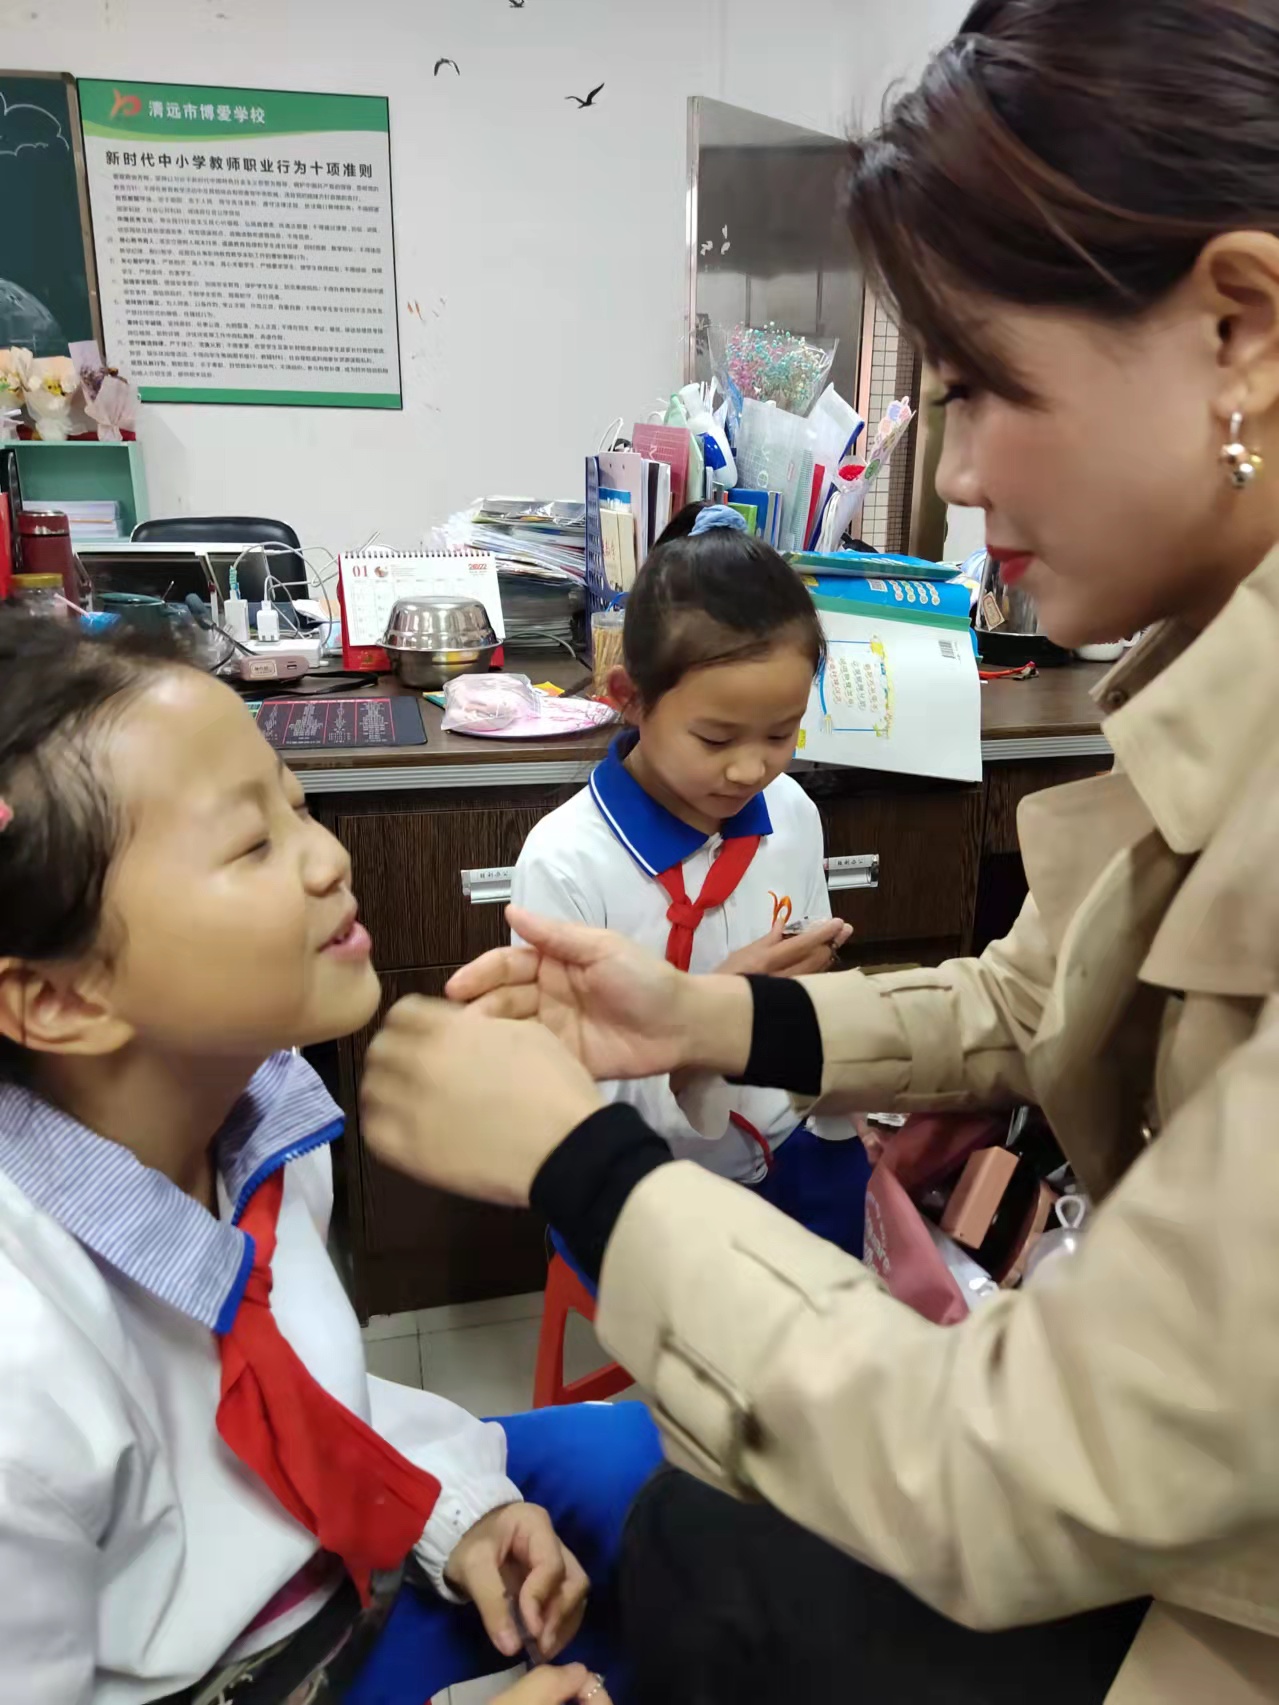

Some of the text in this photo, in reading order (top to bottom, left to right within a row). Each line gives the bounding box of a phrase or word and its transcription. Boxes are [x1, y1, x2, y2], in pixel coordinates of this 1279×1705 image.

[148, 100, 266, 124] 清远市博爱学校
[105, 150, 374, 179] 新时代中小学教师职业行为十项准则
[352, 565, 369, 578] 01
